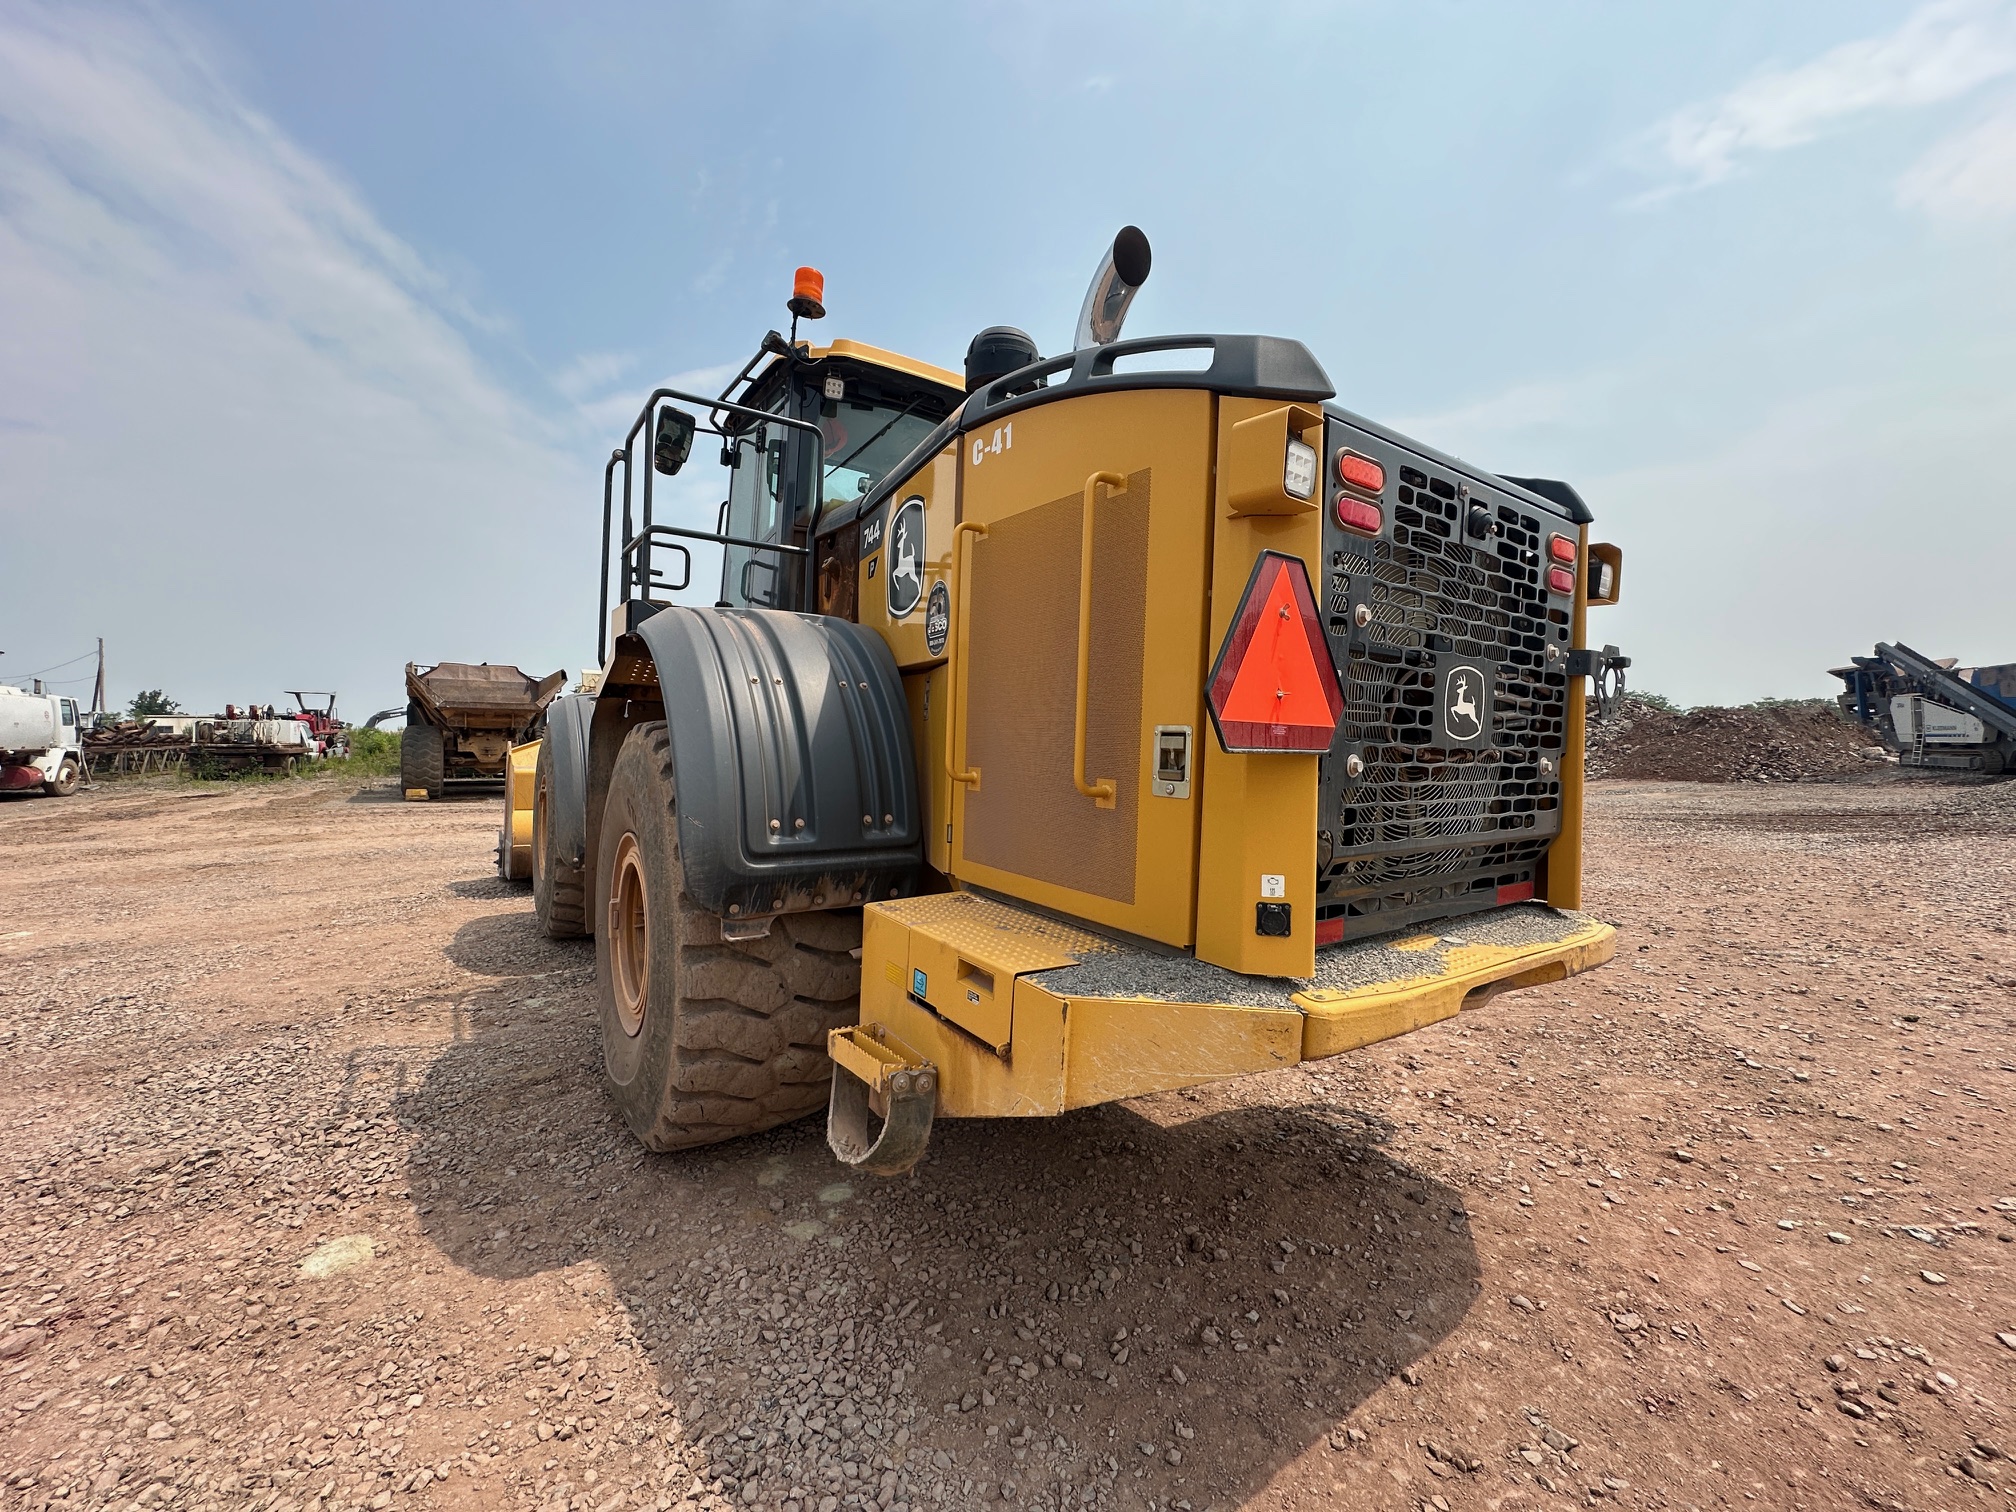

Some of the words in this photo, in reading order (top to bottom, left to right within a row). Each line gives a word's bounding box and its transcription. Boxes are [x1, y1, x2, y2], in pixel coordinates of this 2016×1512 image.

[972, 422, 1012, 466] C-41
[863, 519, 881, 549] 744
[869, 562, 876, 577] P
